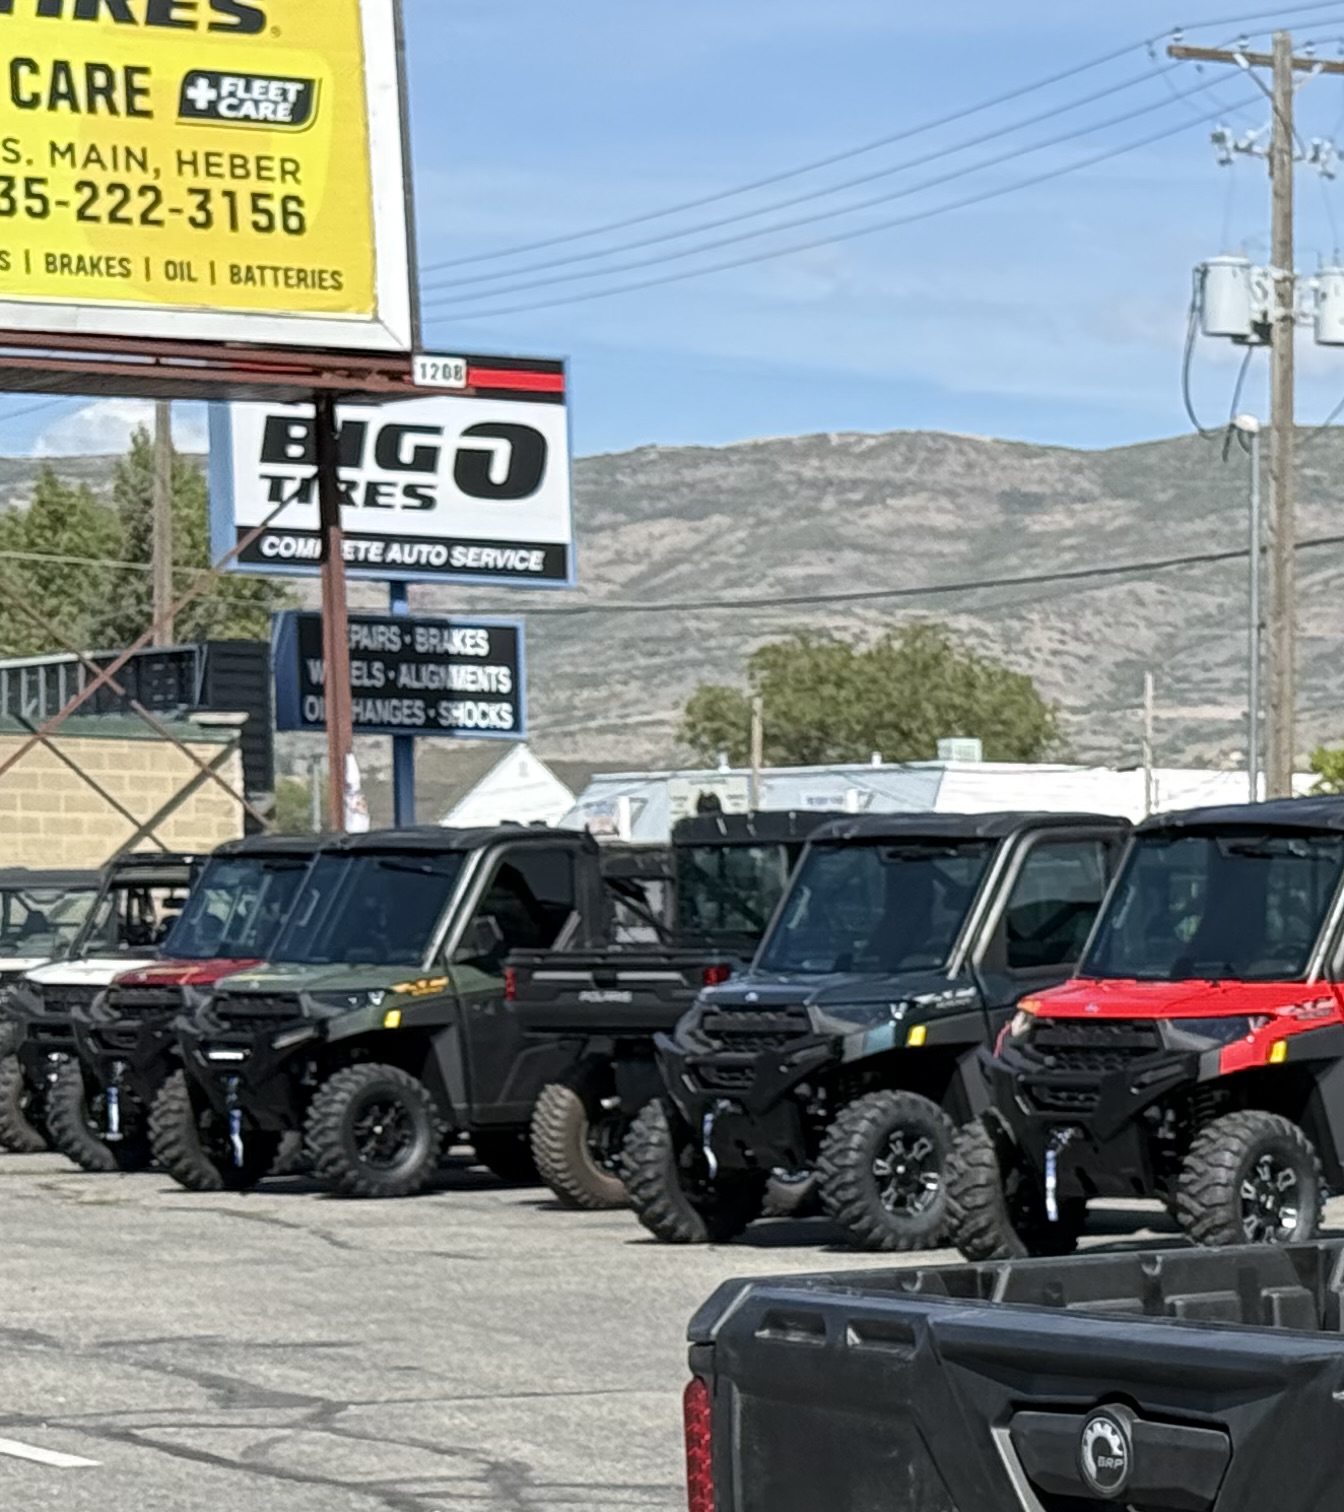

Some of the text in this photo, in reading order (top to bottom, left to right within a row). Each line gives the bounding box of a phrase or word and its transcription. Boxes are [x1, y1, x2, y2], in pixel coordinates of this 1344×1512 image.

[10, 57, 153, 119] CARE
[219, 76, 305, 102] FLEET
[217, 98, 293, 122] CARE
[1, 137, 302, 185] S. MAIN, HEBER
[0, 174, 306, 236] 35-222-3156
[44, 253, 132, 278] BRAKES
[164, 260, 198, 282] OIL
[228, 264, 344, 291] BATTERIES
[260, 415, 549, 501] BIG O
[261, 534, 546, 572] COMETE AUTO SERVICE
[413, 627, 489, 656] BRAKES
[307, 659, 512, 694] WELS ALIGNMENTS
[351, 698, 426, 727] HANGES
[437, 701, 515, 729] SHOCKS
[1098, 1455, 1125, 1469] BRP
